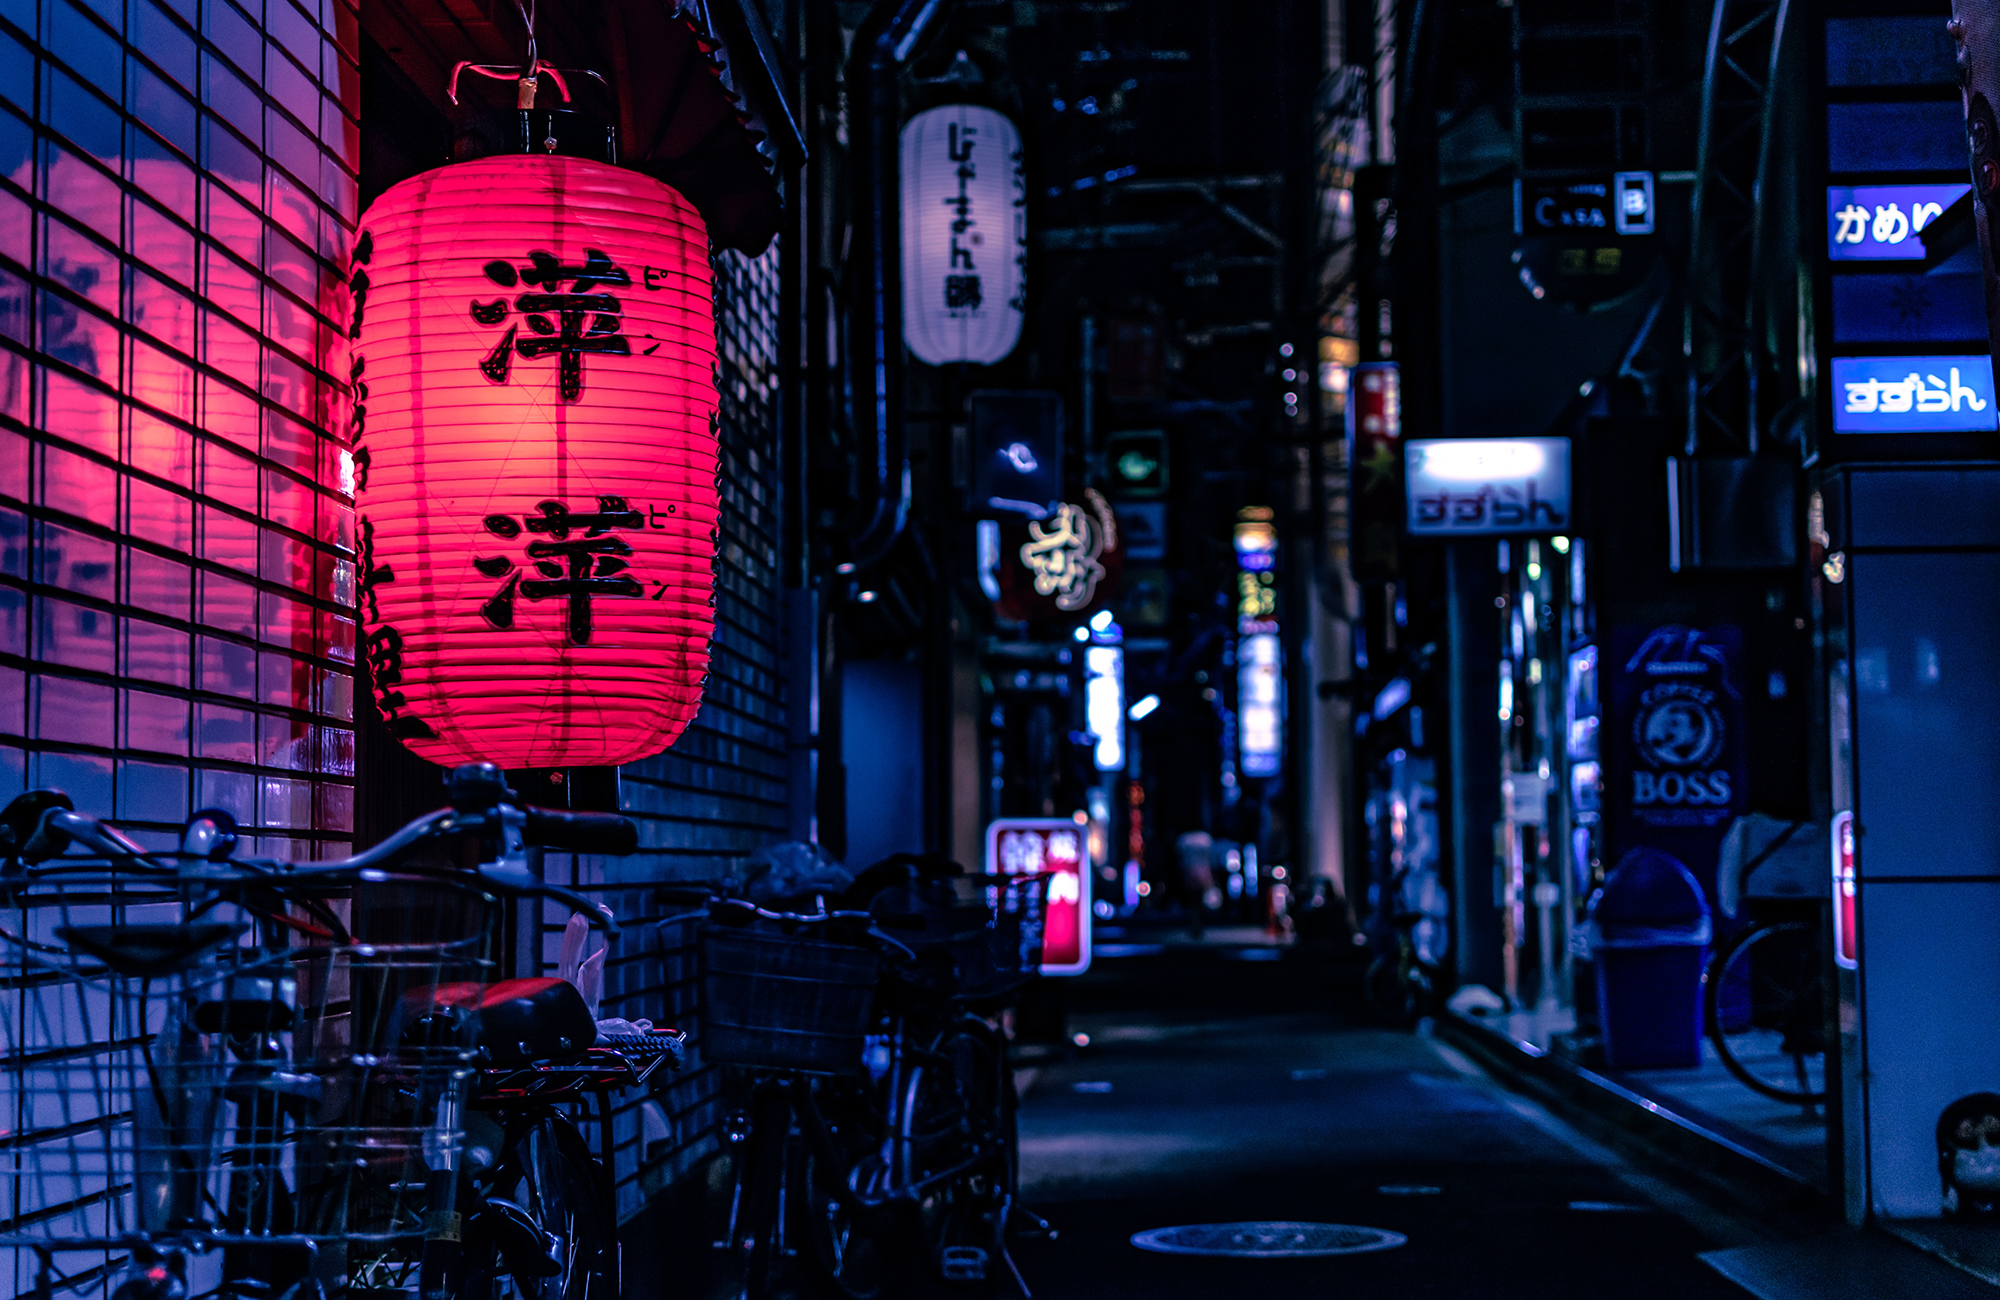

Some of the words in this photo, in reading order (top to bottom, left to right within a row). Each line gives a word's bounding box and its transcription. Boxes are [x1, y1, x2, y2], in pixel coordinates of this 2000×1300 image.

[1844, 366, 1988, 414] すずらん
[1415, 478, 1565, 526] すずらん
[1631, 768, 1733, 806] BOSS
